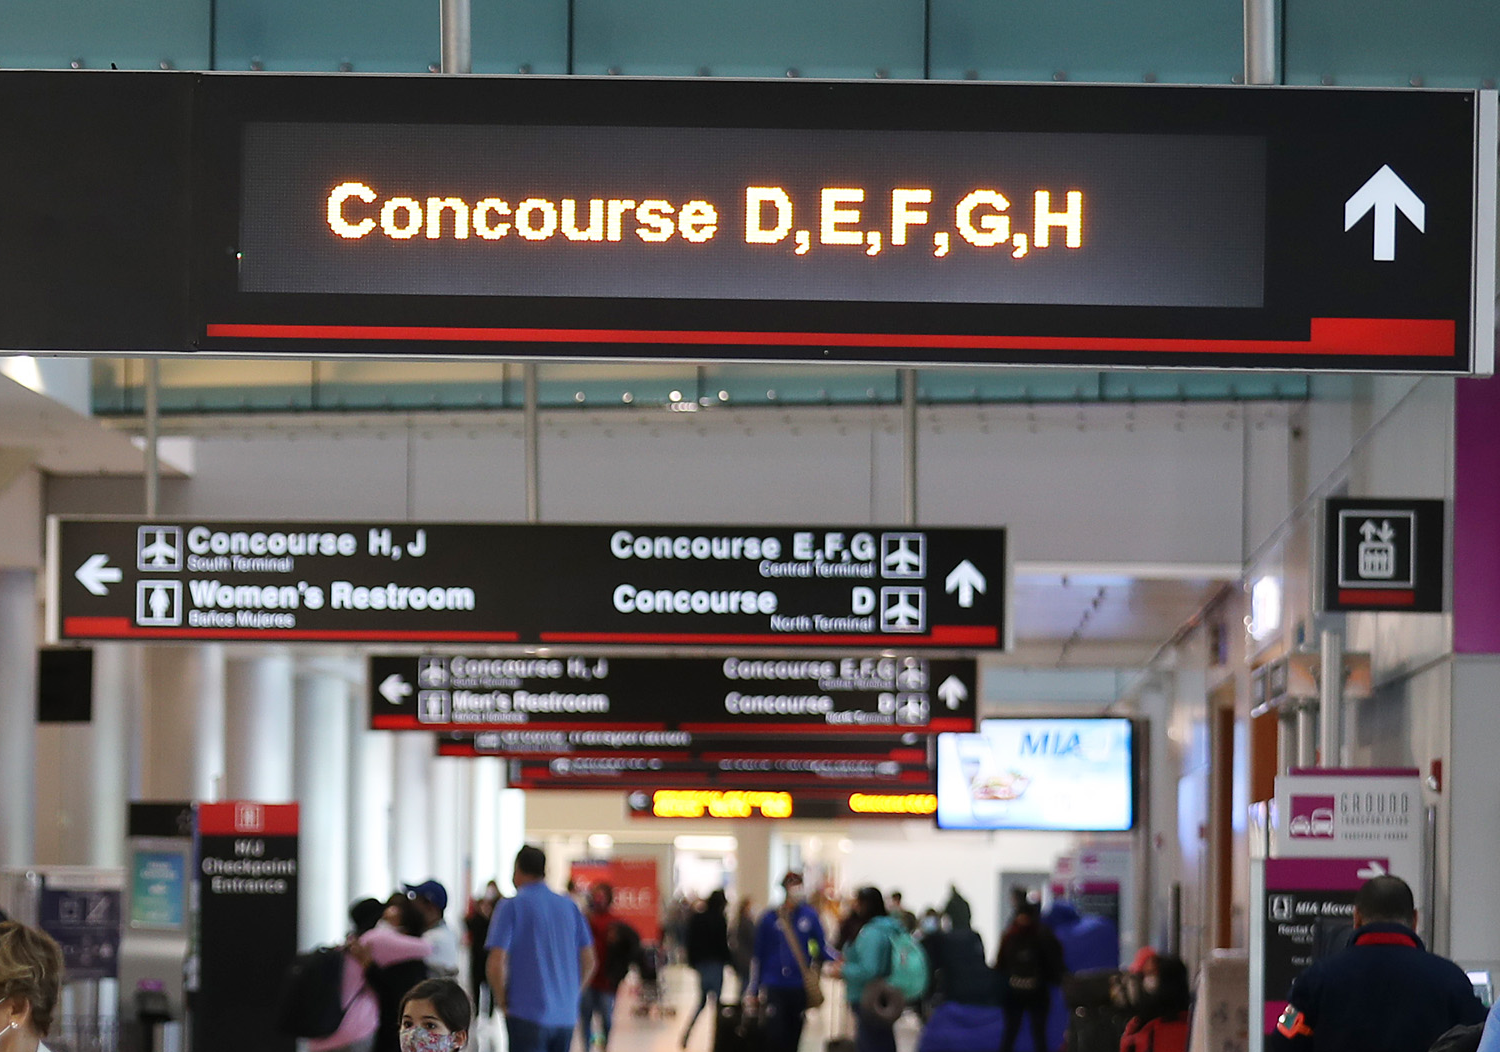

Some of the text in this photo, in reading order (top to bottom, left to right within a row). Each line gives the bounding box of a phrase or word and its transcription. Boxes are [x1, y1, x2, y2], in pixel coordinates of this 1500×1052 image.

[326, 181, 1084, 258] Concourse D,E,F,G,H
[187, 526, 357, 556] Concourse
[610, 530, 782, 561] Concourse
[189, 579, 476, 611] Women's Restroom
[612, 583, 877, 615] Concourse D
[451, 656, 563, 679] Concourse
[722, 657, 836, 679] Concourse
[725, 691, 834, 714] Concourse
[1340, 791, 1409, 816] GROUND
[1295, 901, 1318, 916] MIA
